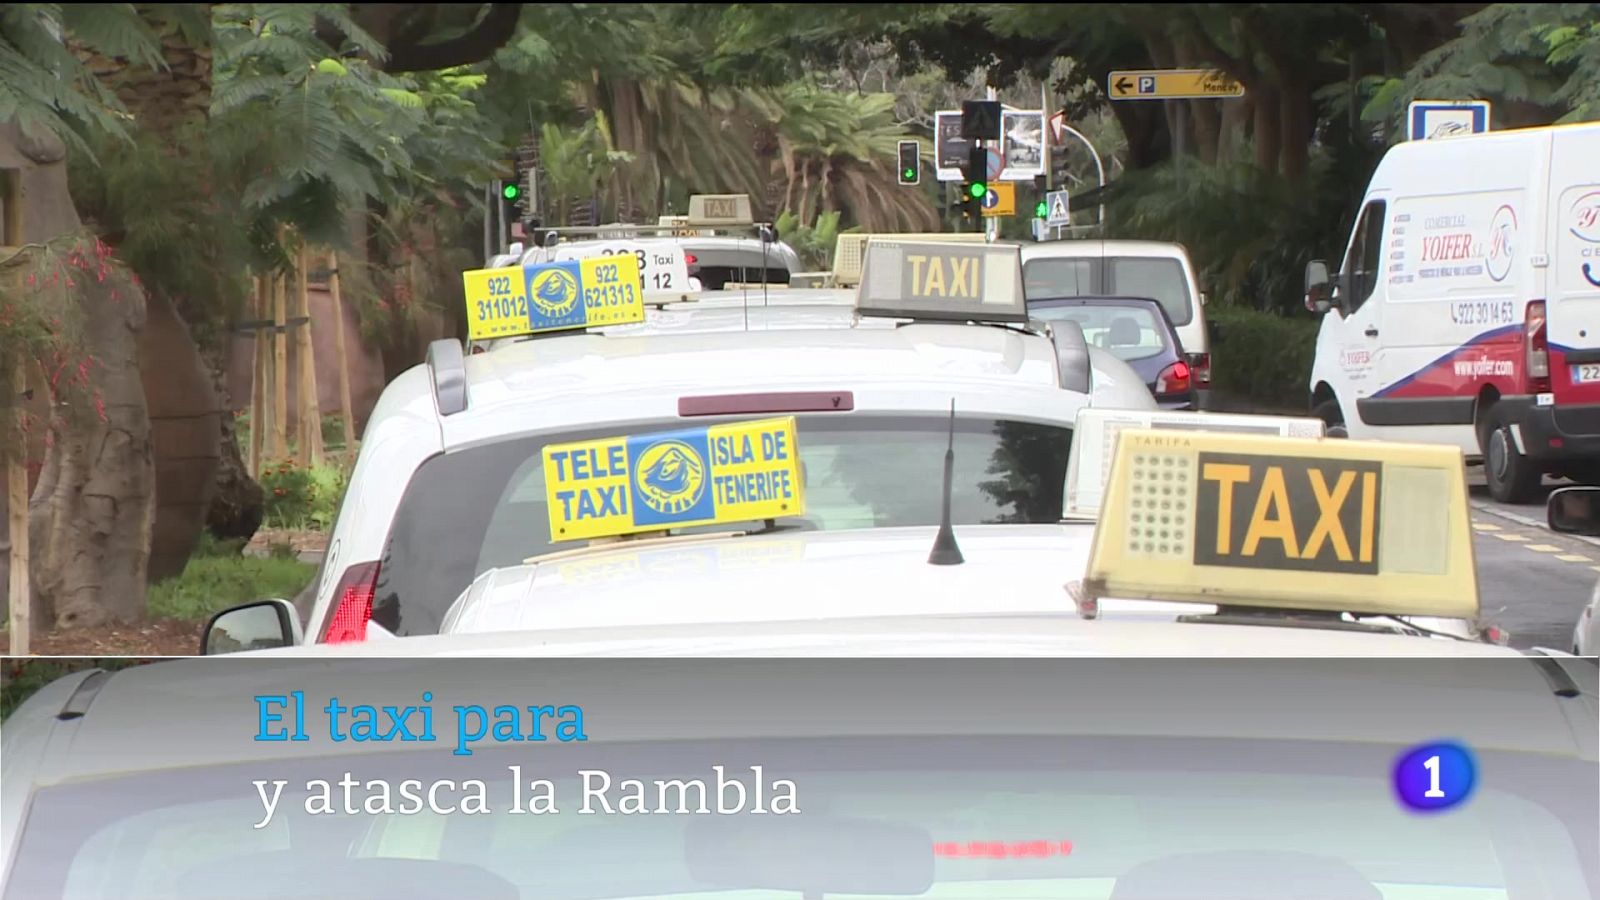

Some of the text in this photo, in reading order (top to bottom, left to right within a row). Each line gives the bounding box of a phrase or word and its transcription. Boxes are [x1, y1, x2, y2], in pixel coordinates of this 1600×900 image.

[704, 200, 737, 218] TAXI
[653, 254, 673, 265] Taxi
[1422, 234, 1472, 261] YOIFER
[488, 276, 511, 296] 922
[595, 264, 619, 283] 922
[653, 273, 672, 289] 12
[907, 254, 980, 298] TAXI
[476, 295, 527, 321] 311012
[585, 283, 634, 308] 621313
[1459, 302, 1514, 324] 922 30 14 63
[1453, 355, 1514, 380] www.yoifer.com
[711, 430, 787, 466] ISLA DE
[1134, 436, 1192, 448] TARIFA
[550, 444, 627, 482] TELE
[714, 469, 792, 505] TENERIFE
[556, 484, 628, 521] TAXI
[1202, 462, 1377, 563] TAXI
